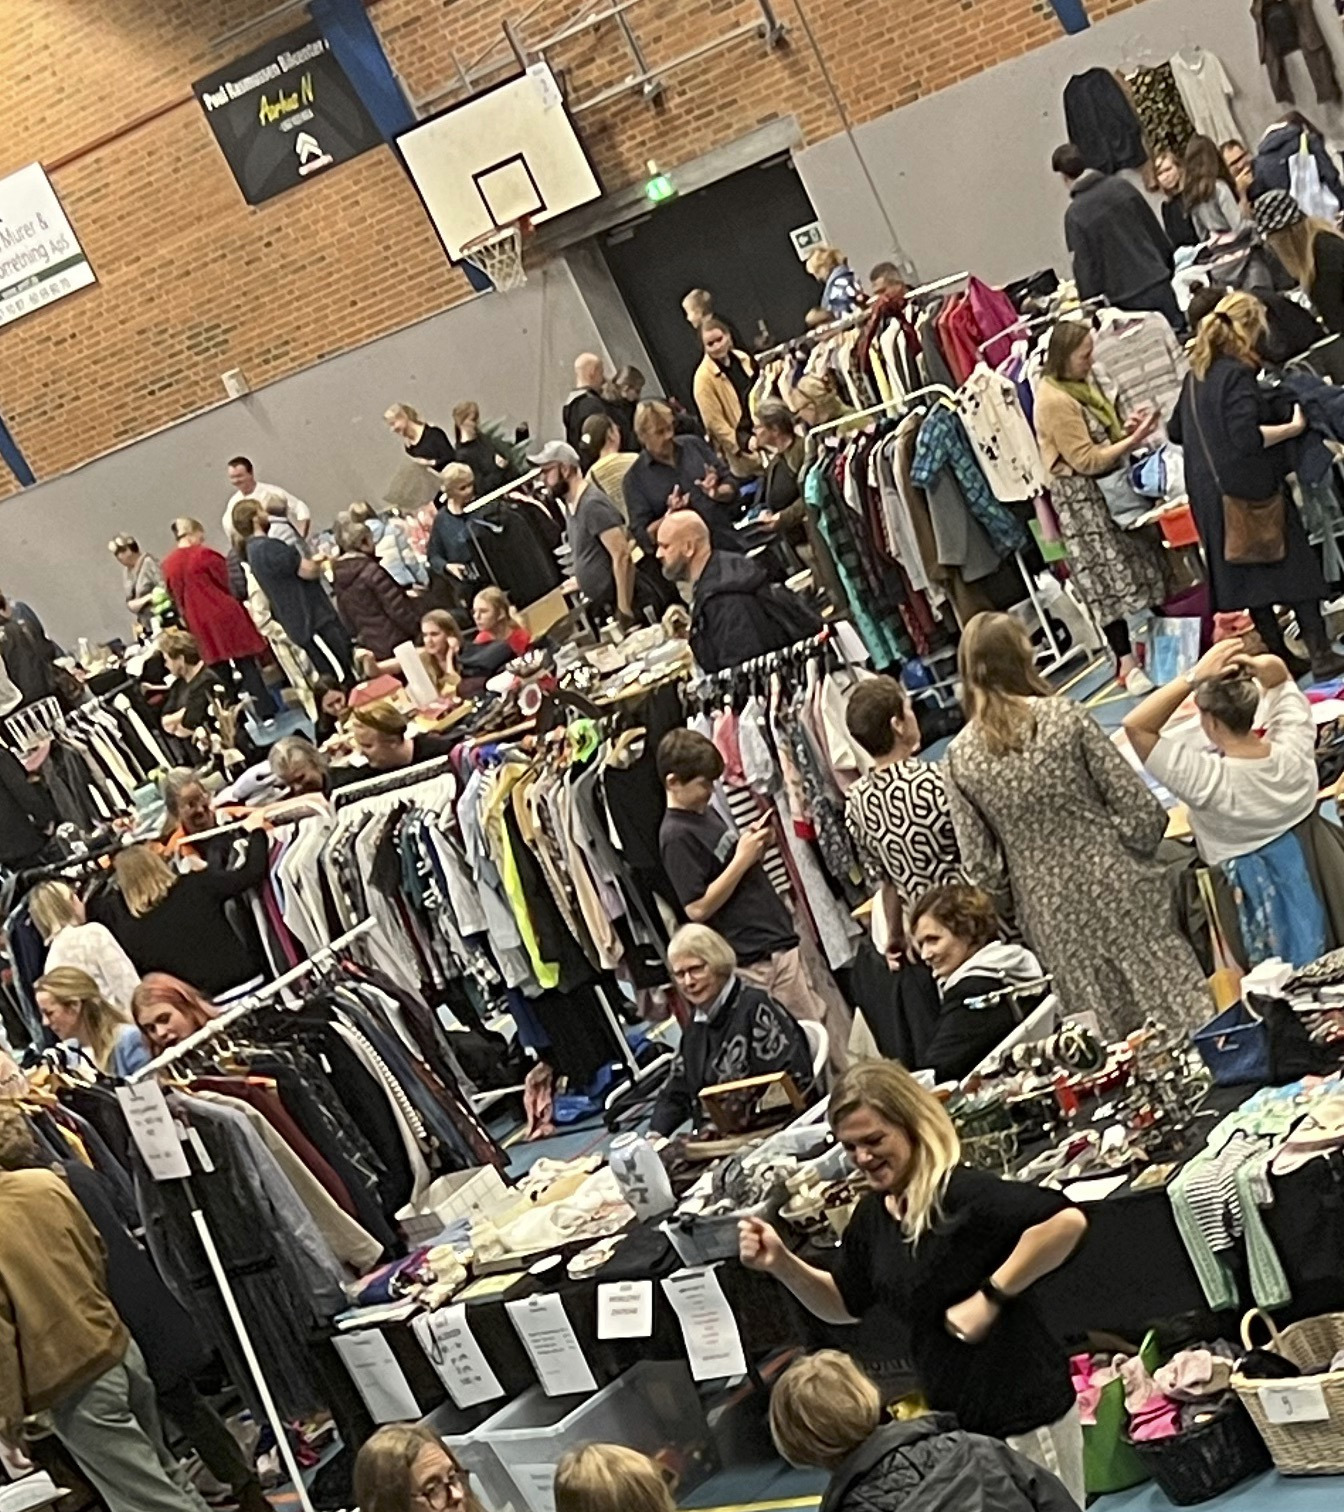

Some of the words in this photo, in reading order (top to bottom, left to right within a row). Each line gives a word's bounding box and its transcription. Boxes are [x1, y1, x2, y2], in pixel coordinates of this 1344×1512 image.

[301, 72, 314, 105] N
[36, 212, 49, 231] &
[50, 233, 71, 256] ApS
